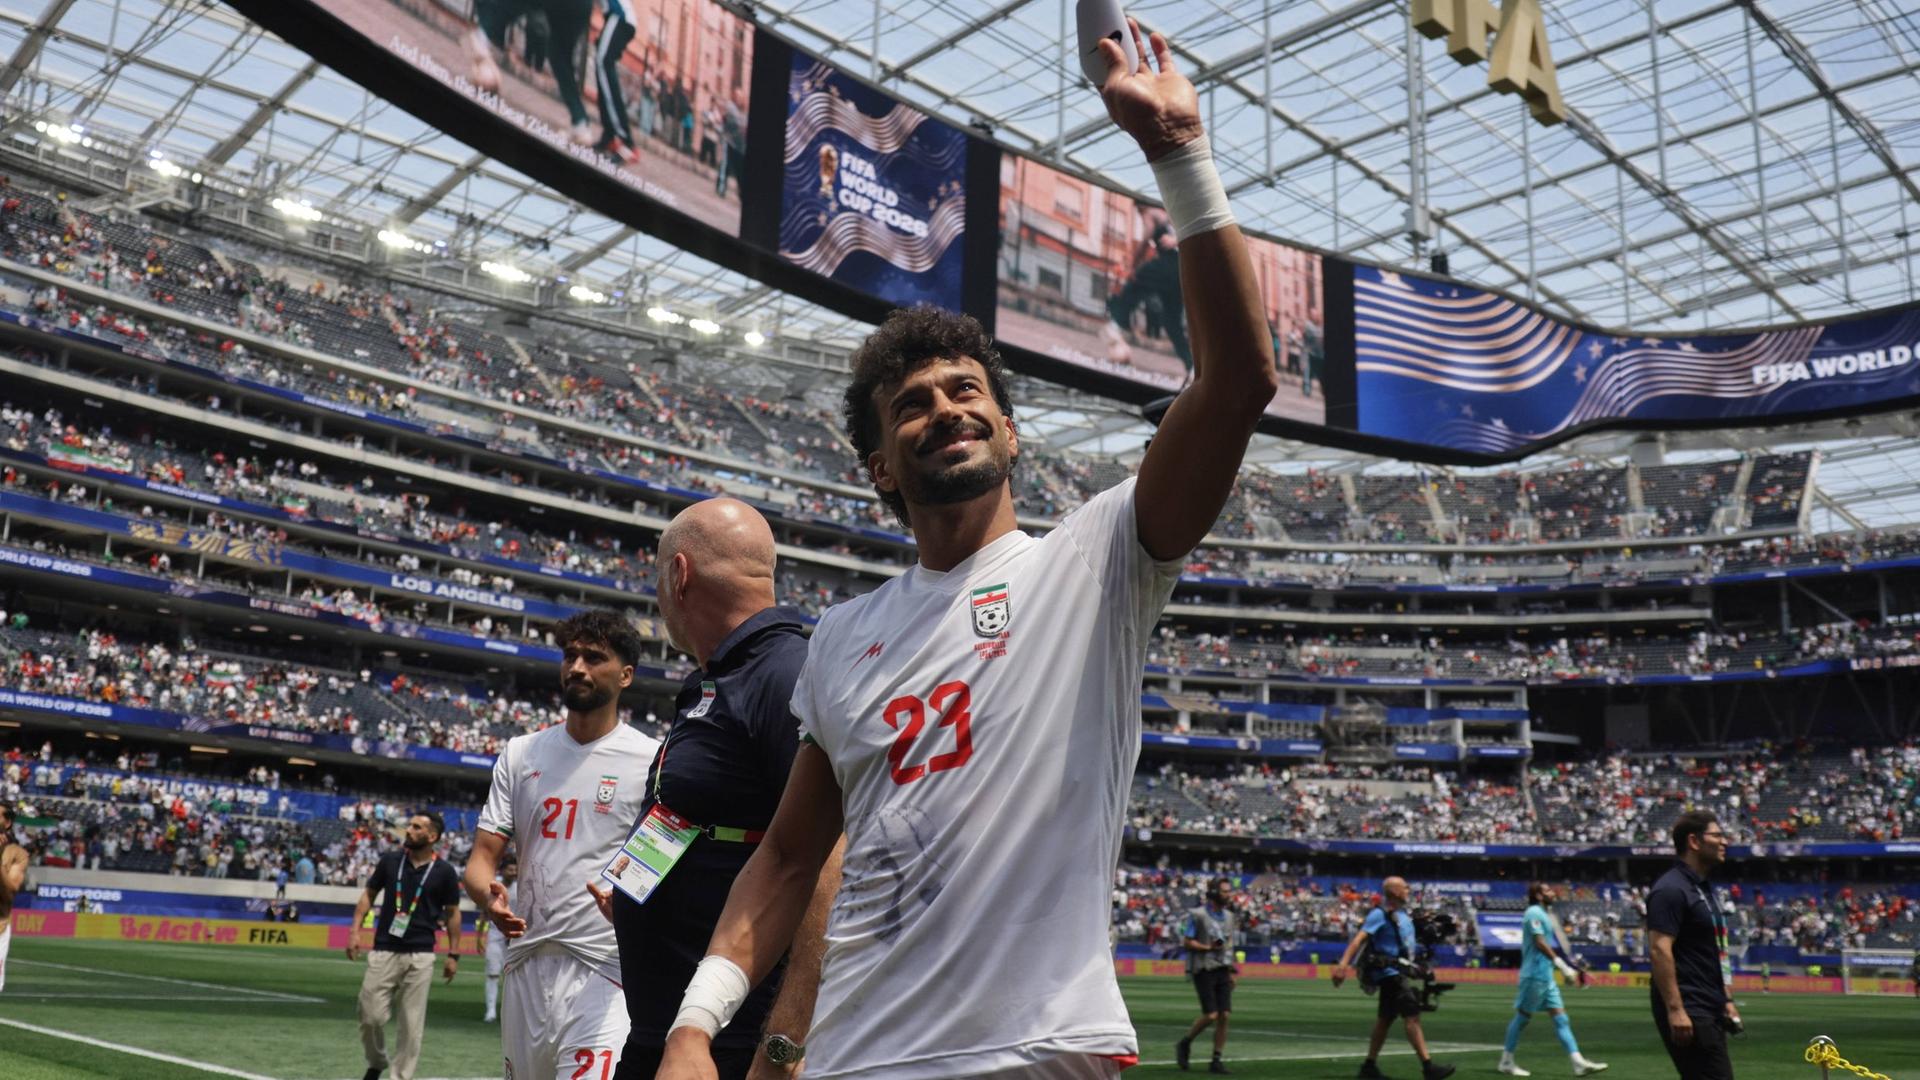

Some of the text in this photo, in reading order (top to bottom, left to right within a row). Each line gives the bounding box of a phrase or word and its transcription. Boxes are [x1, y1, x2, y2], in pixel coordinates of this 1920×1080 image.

[477, 86, 499, 110] kid
[841, 151, 877, 180] FIFA
[839, 169, 899, 206] WORLD
[838, 188, 929, 238] CUP 2026
[1752, 361, 1811, 385] FIFA
[1811, 345, 1912, 378] WORLD
[28, 556, 52, 569] CUP
[391, 574, 525, 611] LOS ANGELES
[16, 693, 54, 709] WORLD
[54, 700, 76, 712] CUP
[75, 702, 113, 717] 2026
[883, 680, 974, 786] 23
[541, 797, 579, 840] 21
[16, 914, 46, 933] DAY
[249, 928, 288, 944] FIFA
[570, 1048, 613, 1080] 21
